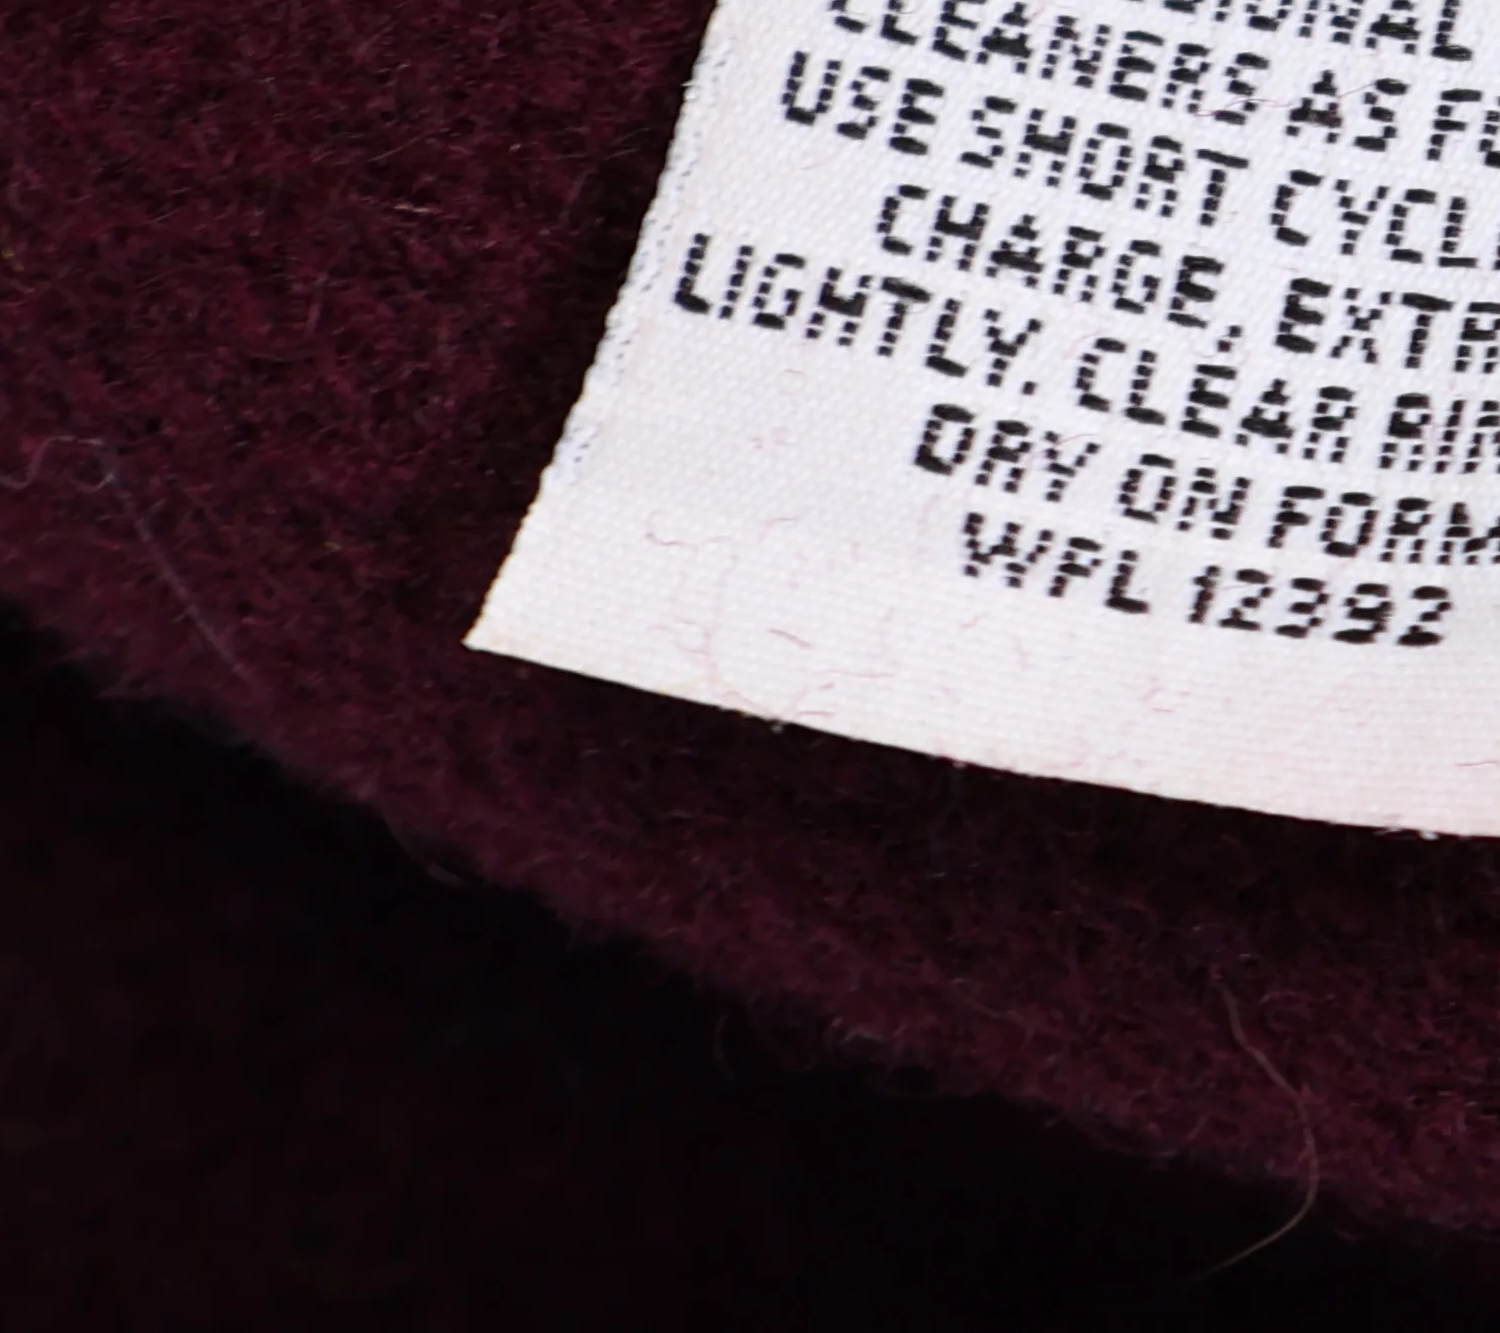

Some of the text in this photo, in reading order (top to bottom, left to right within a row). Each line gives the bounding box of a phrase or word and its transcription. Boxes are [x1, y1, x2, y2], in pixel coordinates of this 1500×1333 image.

[781, 50, 945, 156] USE
[960, 95, 1250, 226] SHORT
[1285, 69, 1410, 153] AS
[1075, 336, 1358, 464] CLEAR
[914, 402, 1102, 502] DRY
[1118, 452, 1252, 541] ON
[961, 511, 1452, 648] WPL 12392
